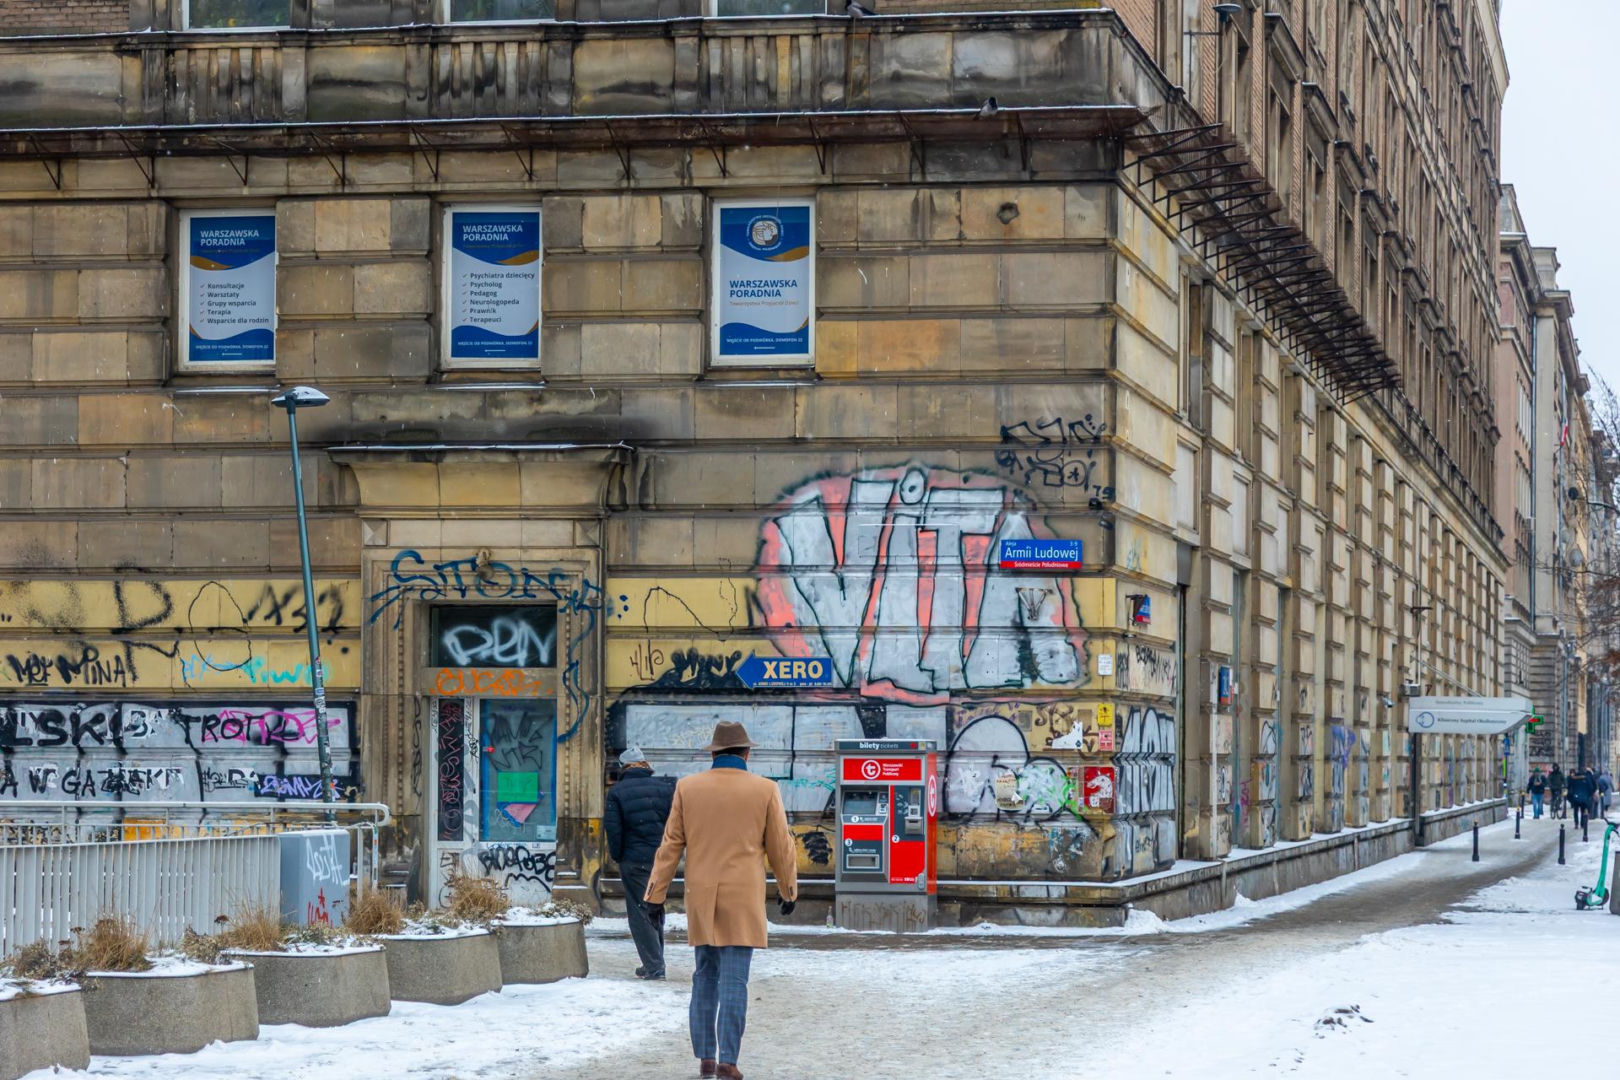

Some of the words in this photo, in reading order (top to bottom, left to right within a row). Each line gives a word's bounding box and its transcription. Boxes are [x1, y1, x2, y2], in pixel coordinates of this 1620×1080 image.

[462, 224, 523, 233] WARSZAWSKA
[200, 229, 259, 238] WARSZAWSKA
[463, 233, 509, 241] PORADNIA
[200, 238, 246, 246] PORADNIA
[470, 272, 504, 280] Psychiatra
[470, 281, 502, 289] Psycholog
[729, 279, 798, 288] WARSZAWSKA
[729, 289, 781, 298] PORADNIA
[1005, 546, 1031, 558] Armii
[1035, 546, 1079, 561] Ludowej
[763, 661, 823, 679] XERO
[859, 742, 880, 750] bilety
